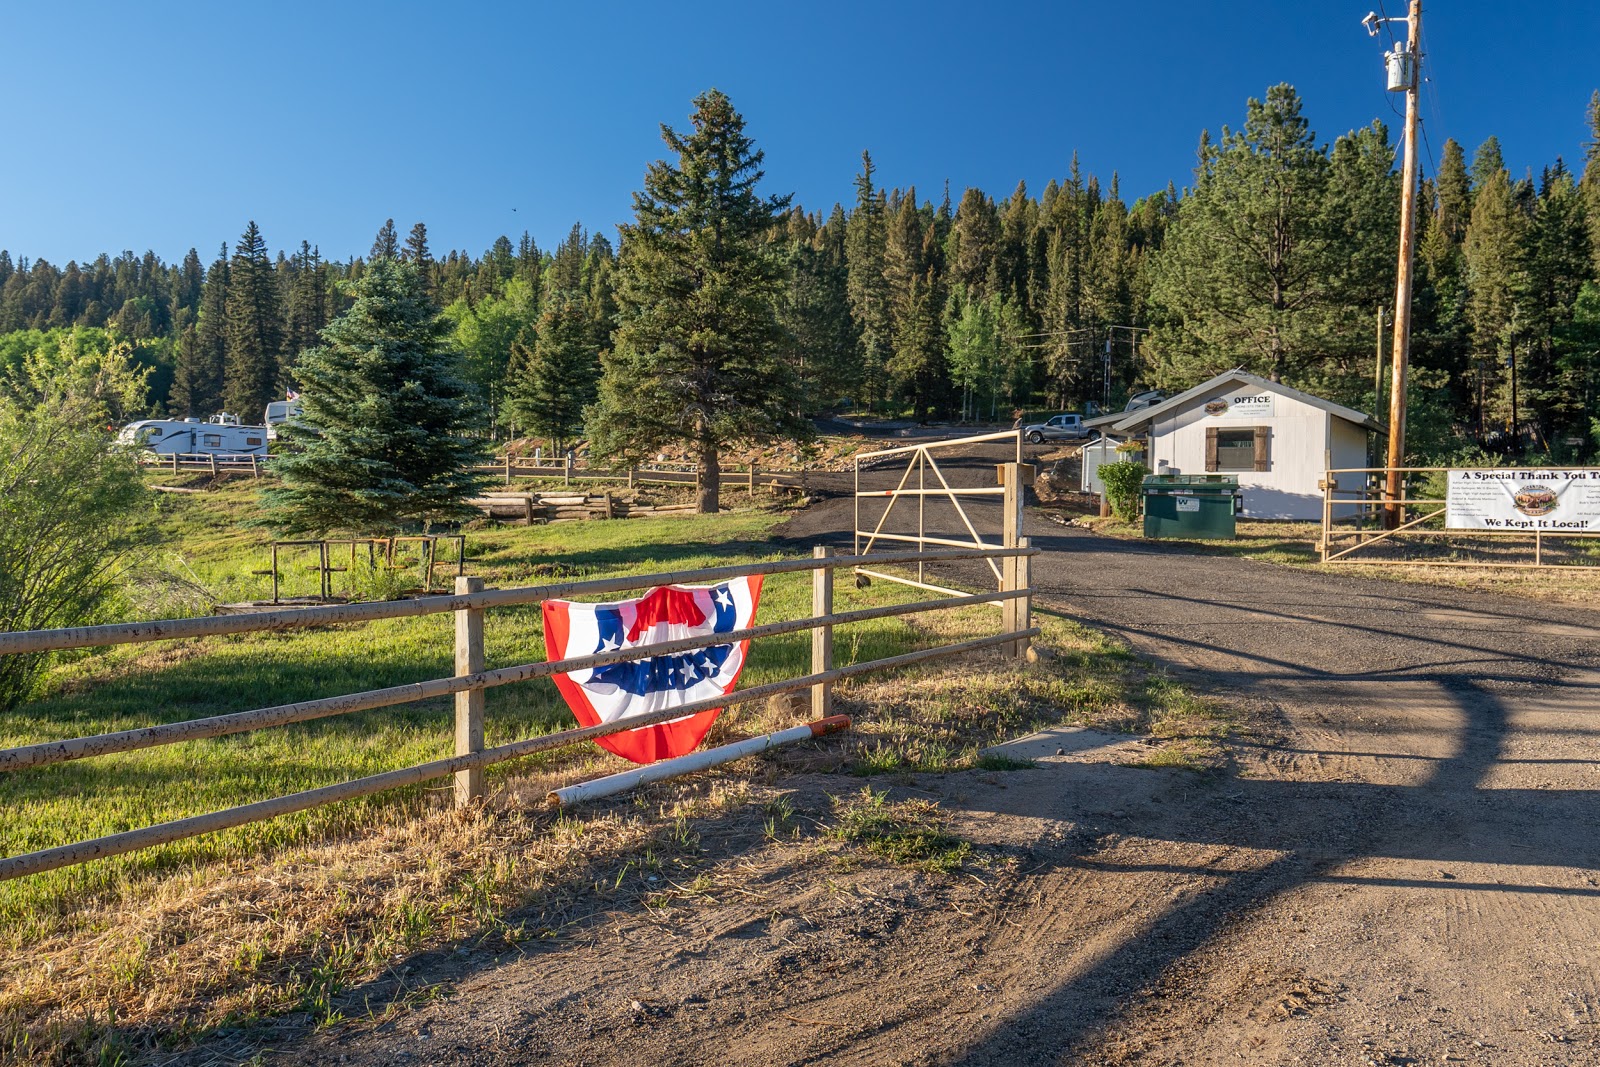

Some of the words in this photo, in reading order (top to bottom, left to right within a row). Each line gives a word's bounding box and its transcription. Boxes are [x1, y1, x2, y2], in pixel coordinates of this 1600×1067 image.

[1234, 396, 1271, 404] OFFICE
[1474, 472, 1516, 480] Special
[1563, 472, 1586, 480] You
[1505, 519, 1534, 528] Kept
